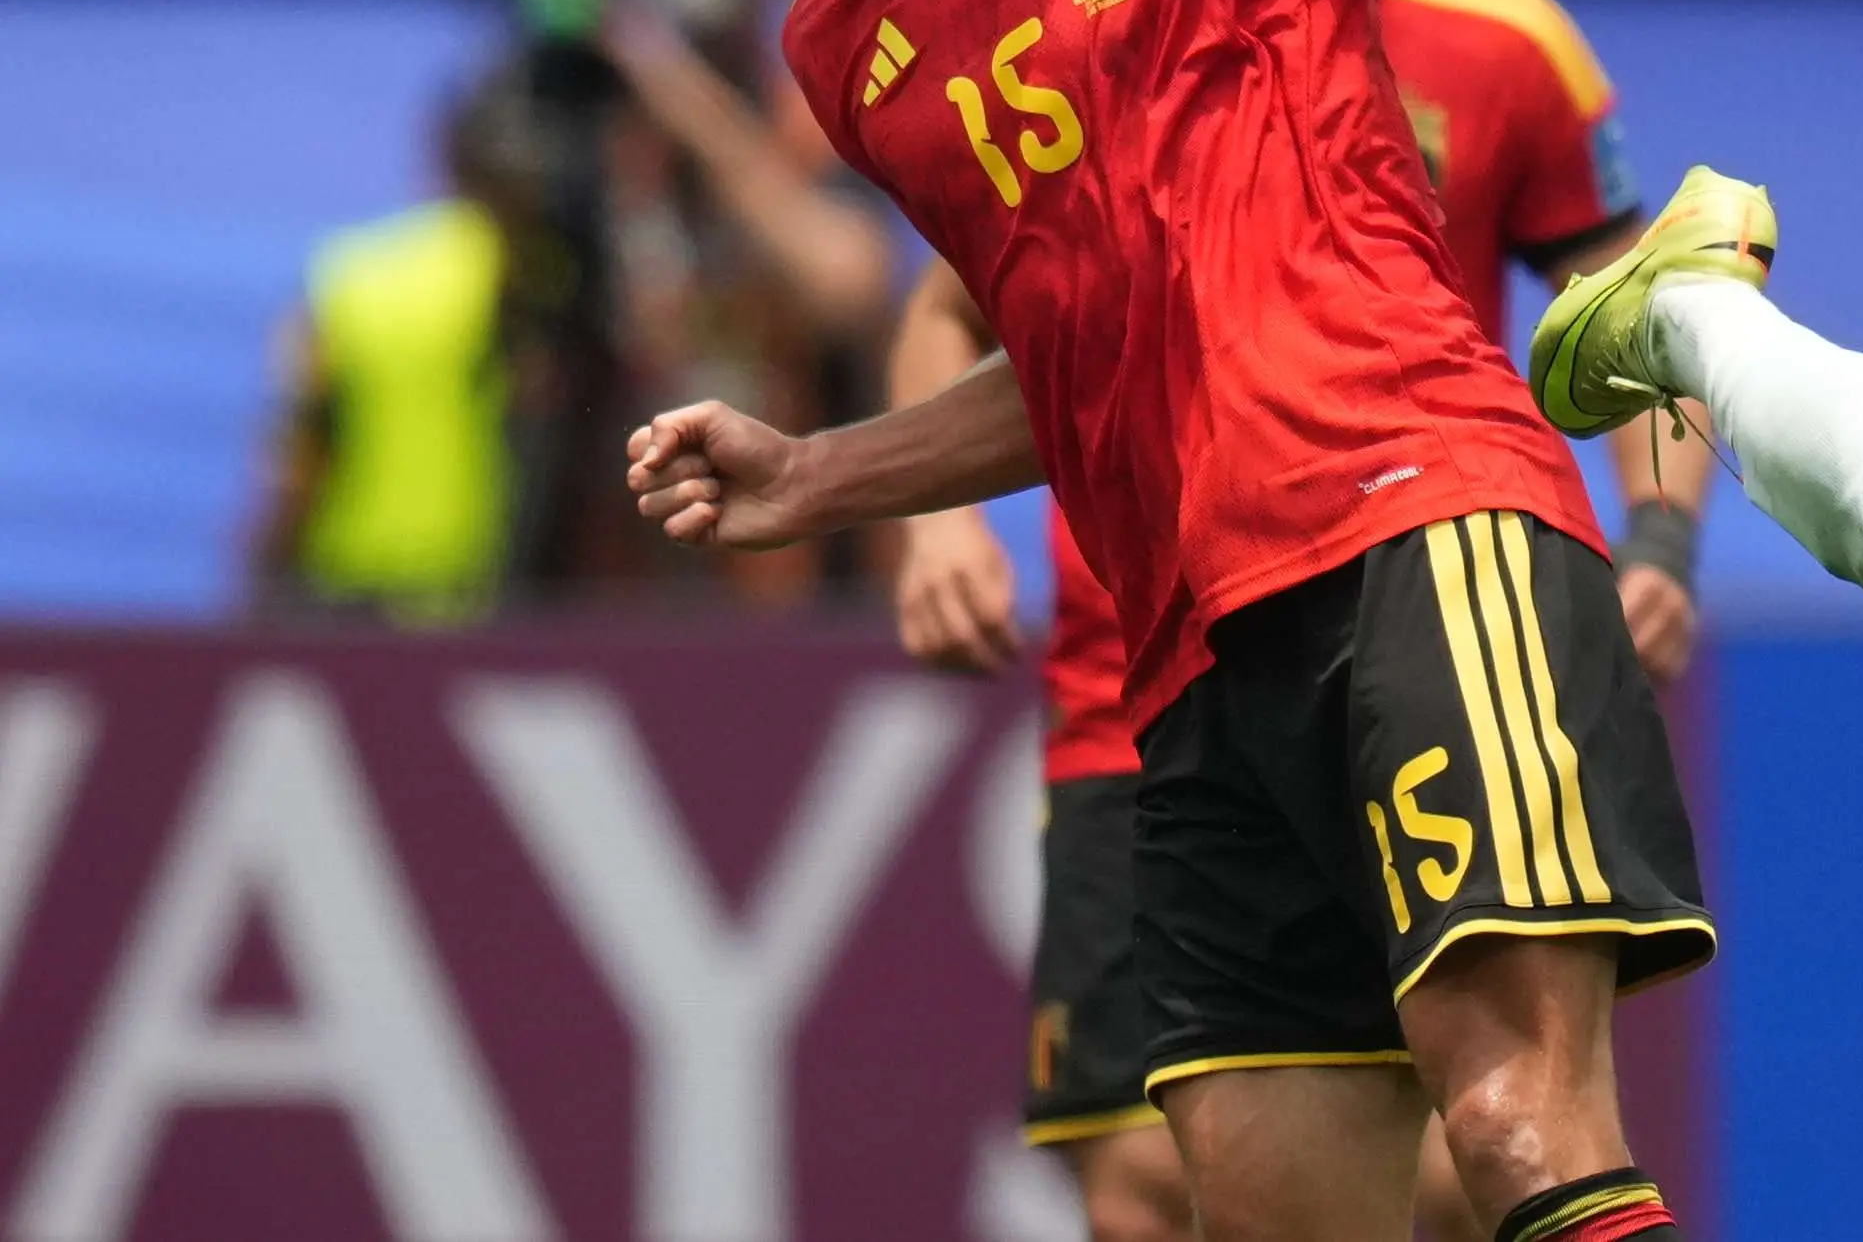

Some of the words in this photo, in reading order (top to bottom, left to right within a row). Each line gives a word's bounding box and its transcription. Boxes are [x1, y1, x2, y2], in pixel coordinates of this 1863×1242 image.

[946, 16, 1084, 208] 15
[1366, 746, 1473, 934] 15
[0, 671, 1095, 1242] AY
